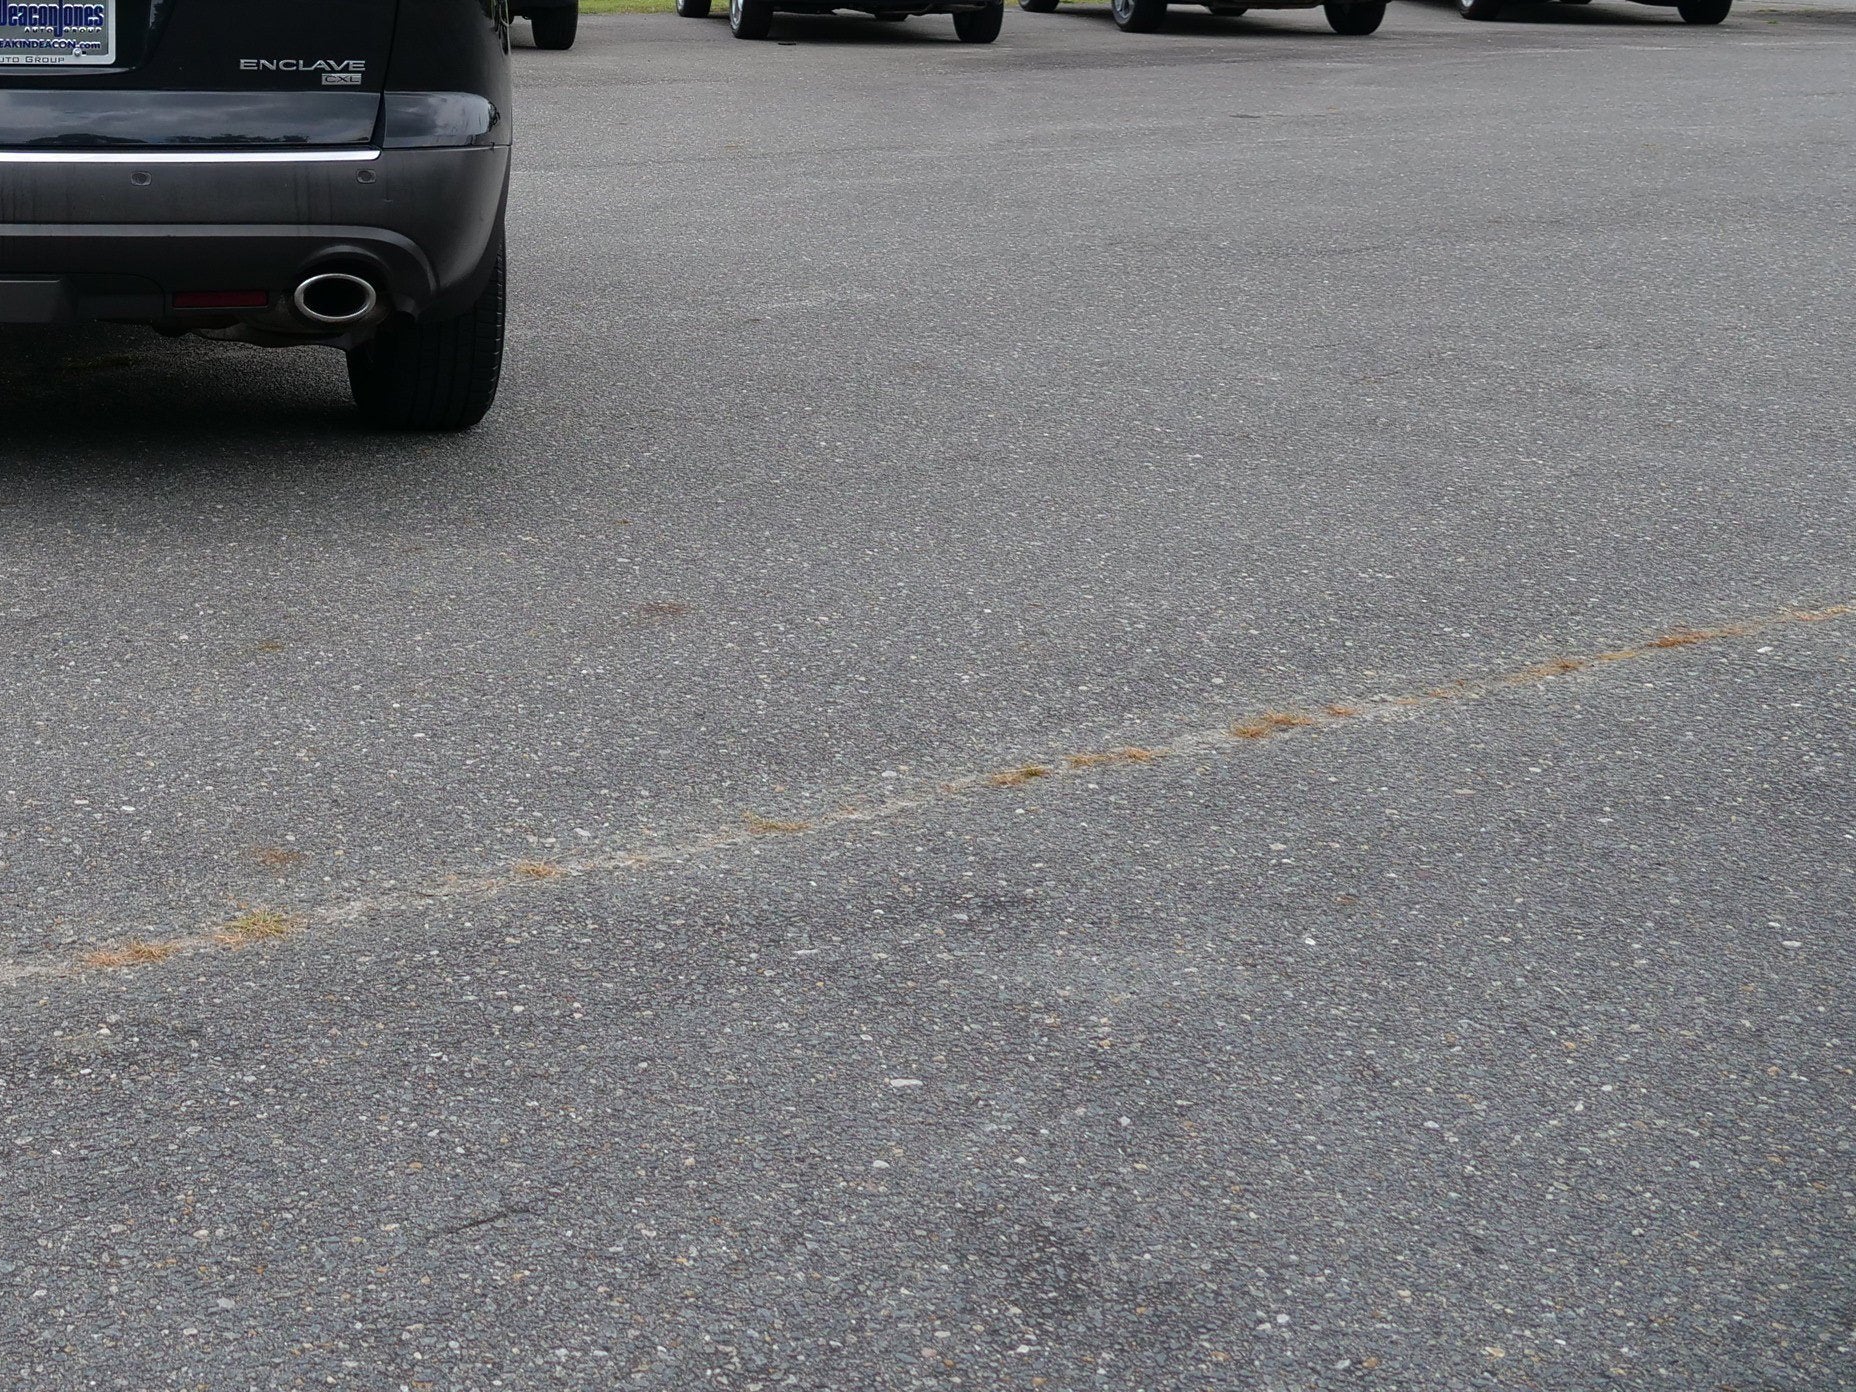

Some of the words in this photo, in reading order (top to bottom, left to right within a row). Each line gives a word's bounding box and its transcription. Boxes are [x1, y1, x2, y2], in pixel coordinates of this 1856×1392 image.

[24, 26, 54, 34] AUTO
[63, 26, 102, 34] GROUP
[239, 59, 366, 71] ENCLAVE
[324, 74, 361, 84] CXL
